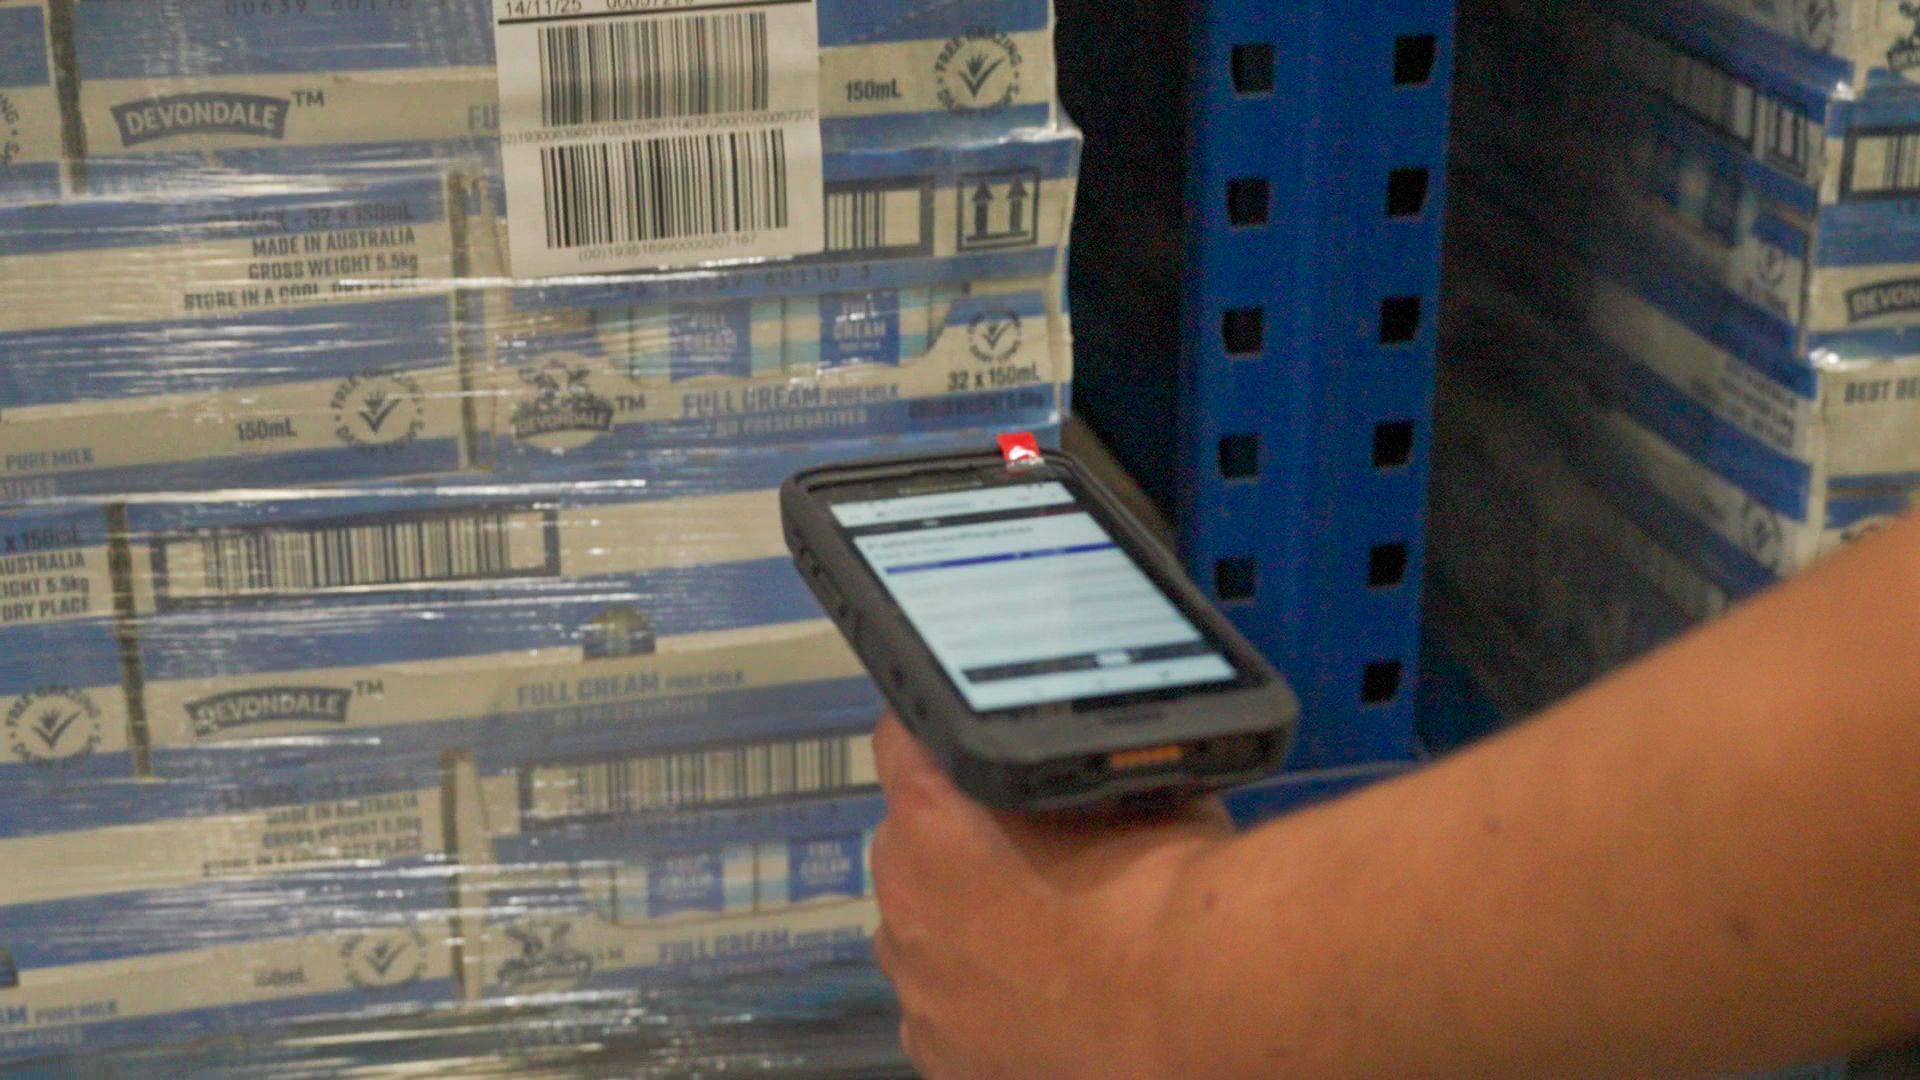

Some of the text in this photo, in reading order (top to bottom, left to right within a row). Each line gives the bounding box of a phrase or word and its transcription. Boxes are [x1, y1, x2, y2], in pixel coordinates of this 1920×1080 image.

[505, 0, 582, 17] 14/11/25
[846, 78, 902, 103] 150mL
[124, 89, 326, 137] DEVONDALE TM
[252, 226, 416, 258] MADE IN AUSTRALIA
[248, 252, 418, 281] GROSS WEIGHT 5.5kg
[184, 290, 239, 311] STORE
[242, 288, 259, 306] IN
[264, 286, 274, 303] A
[947, 369, 969, 392] 32
[236, 416, 298, 441] 150mL
[52, 447, 96, 467] MILK
[47, 573, 90, 595] 5.5kg
[40, 595, 90, 618] PLACE
[515, 681, 569, 706] FULL
[575, 671, 660, 700] CREAM
[196, 679, 385, 730] DEVONDALE TM
